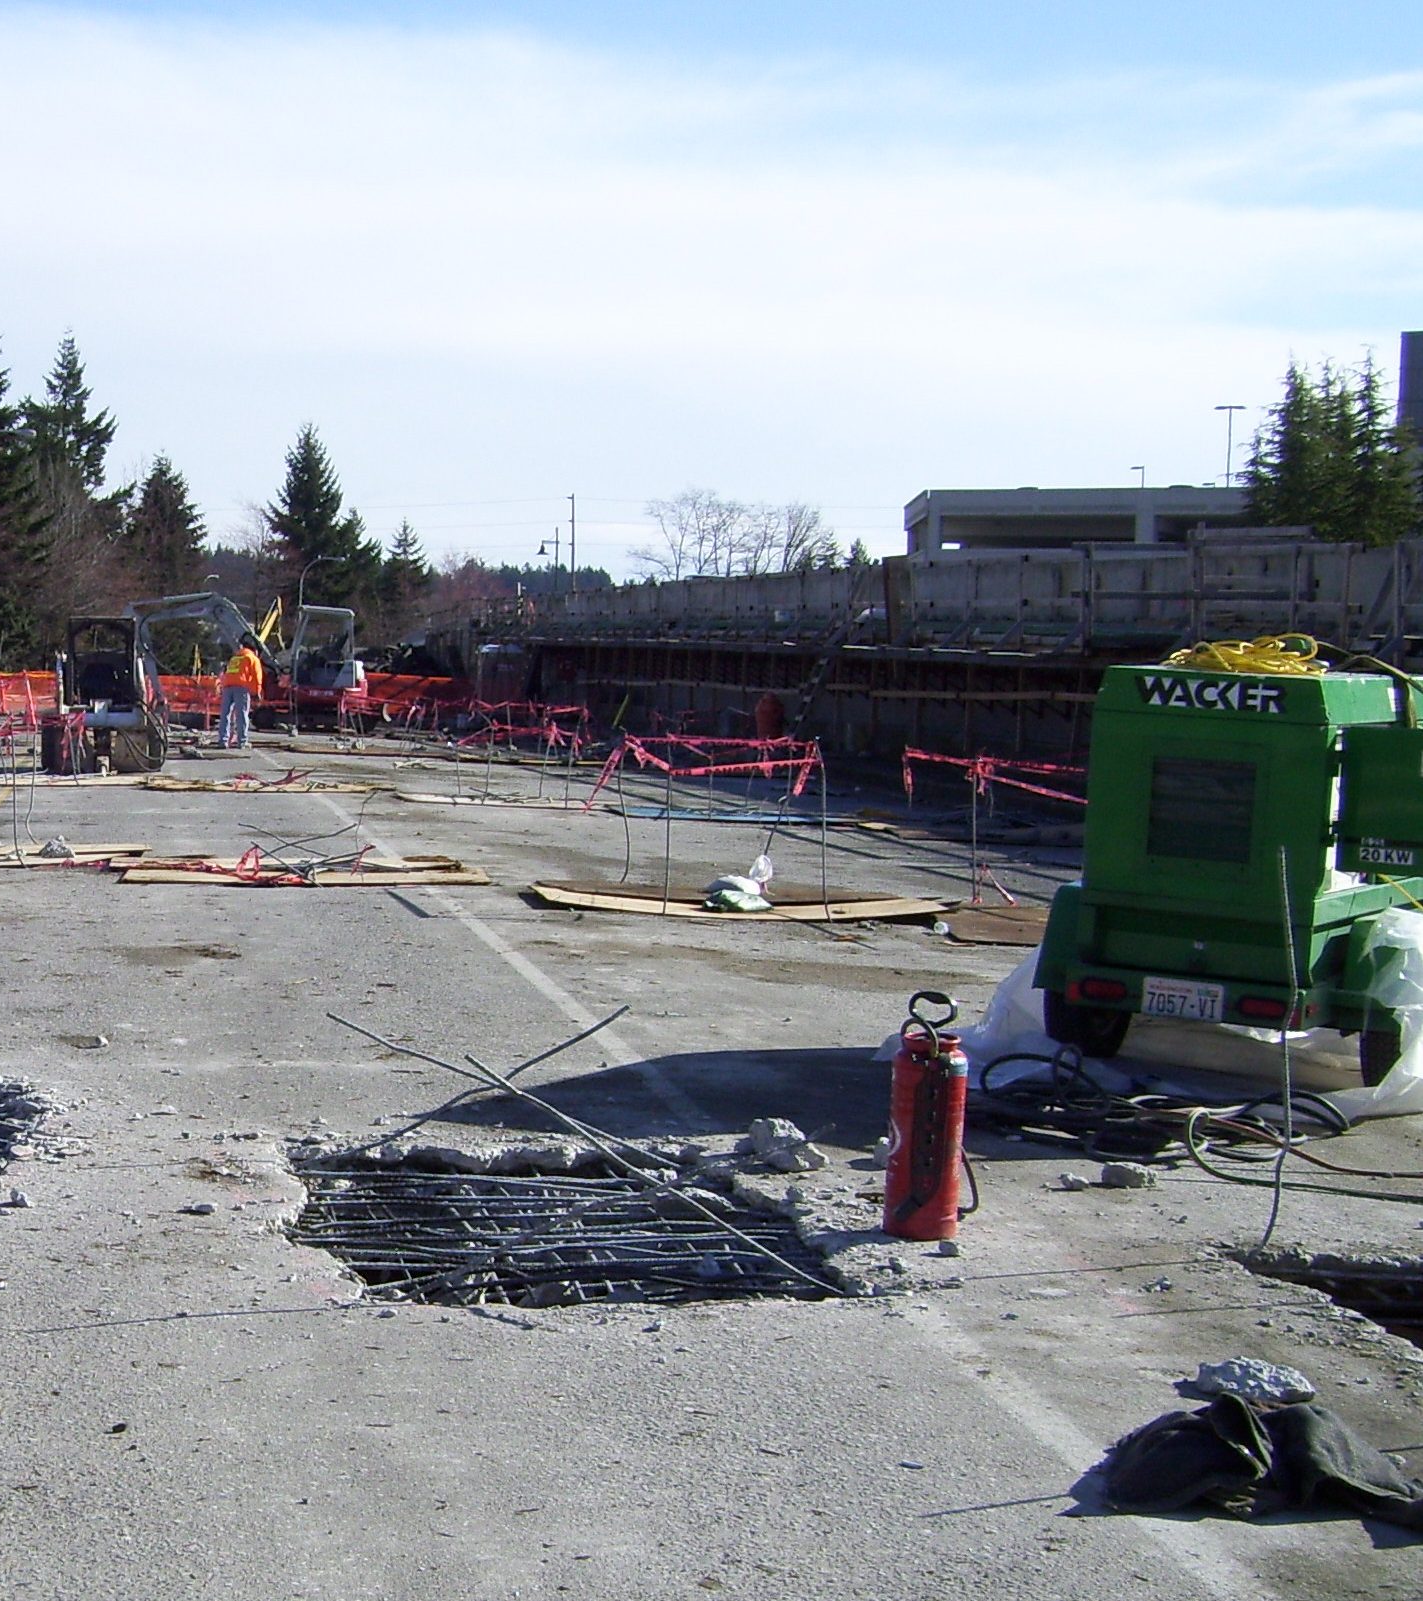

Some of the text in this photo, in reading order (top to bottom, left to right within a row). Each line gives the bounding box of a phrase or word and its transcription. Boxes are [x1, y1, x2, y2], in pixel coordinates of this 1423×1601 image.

[1135, 675, 1287, 714] WACKER
[1361, 848, 1410, 864] 20 KW
